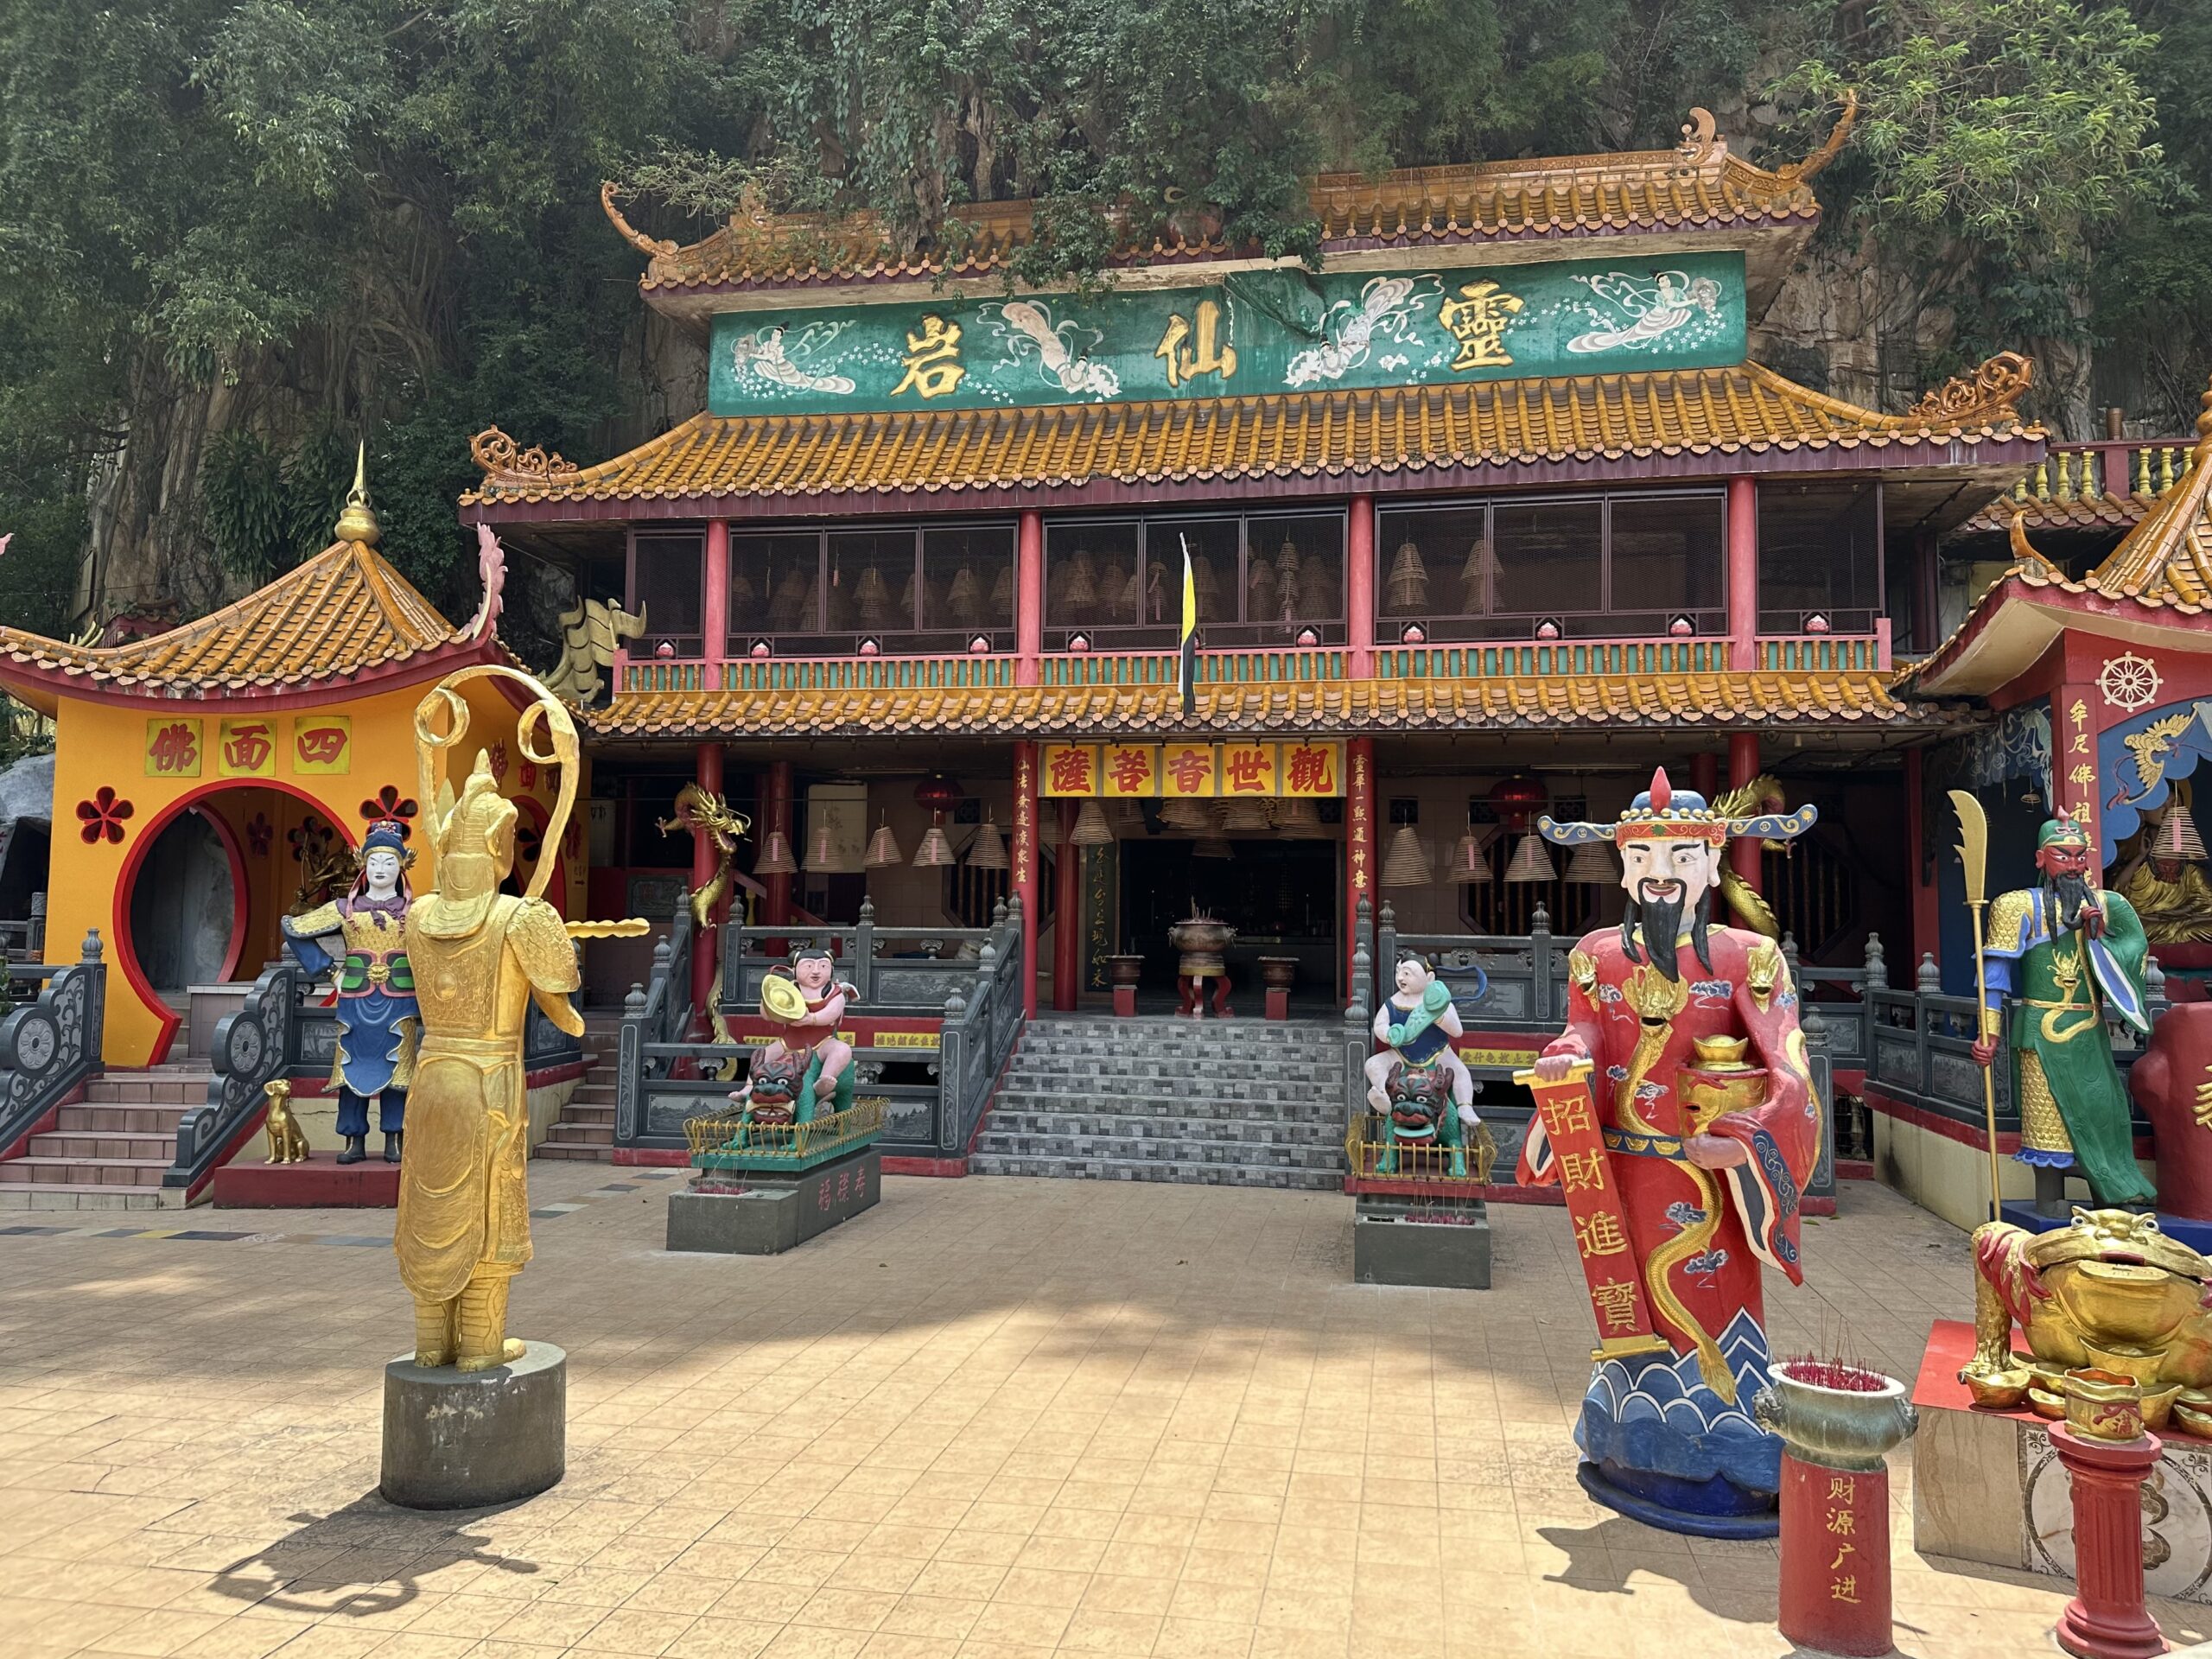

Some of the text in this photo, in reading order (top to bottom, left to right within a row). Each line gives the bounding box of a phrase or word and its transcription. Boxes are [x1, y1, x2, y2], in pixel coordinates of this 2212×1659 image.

[2068, 698, 2098, 889] 牟尼佛祖
[1541, 1094, 1640, 1335] 招財進寶
[1826, 1476, 1862, 1605] 财源广进
